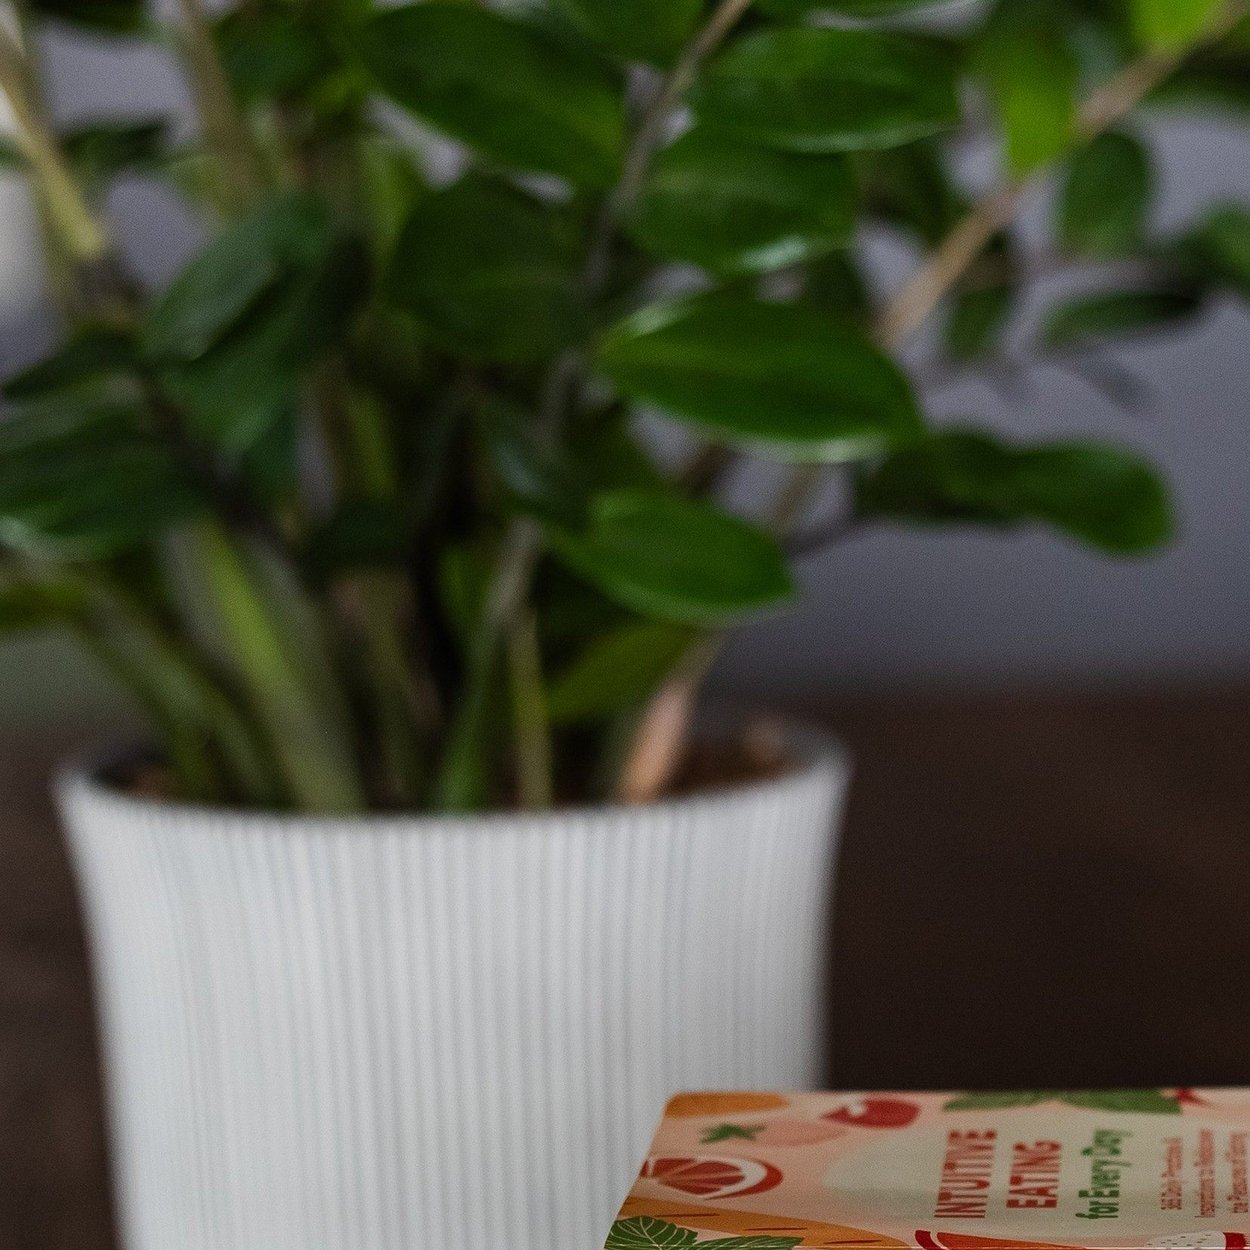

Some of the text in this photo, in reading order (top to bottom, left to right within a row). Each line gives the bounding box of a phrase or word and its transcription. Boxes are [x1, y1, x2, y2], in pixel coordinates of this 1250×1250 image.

[934, 1128, 997, 1218] INTUITIVE
[1006, 1140, 1062, 1208] EATING
[1078, 1160, 1132, 1198] Every
[1075, 1201, 1119, 1219] for
